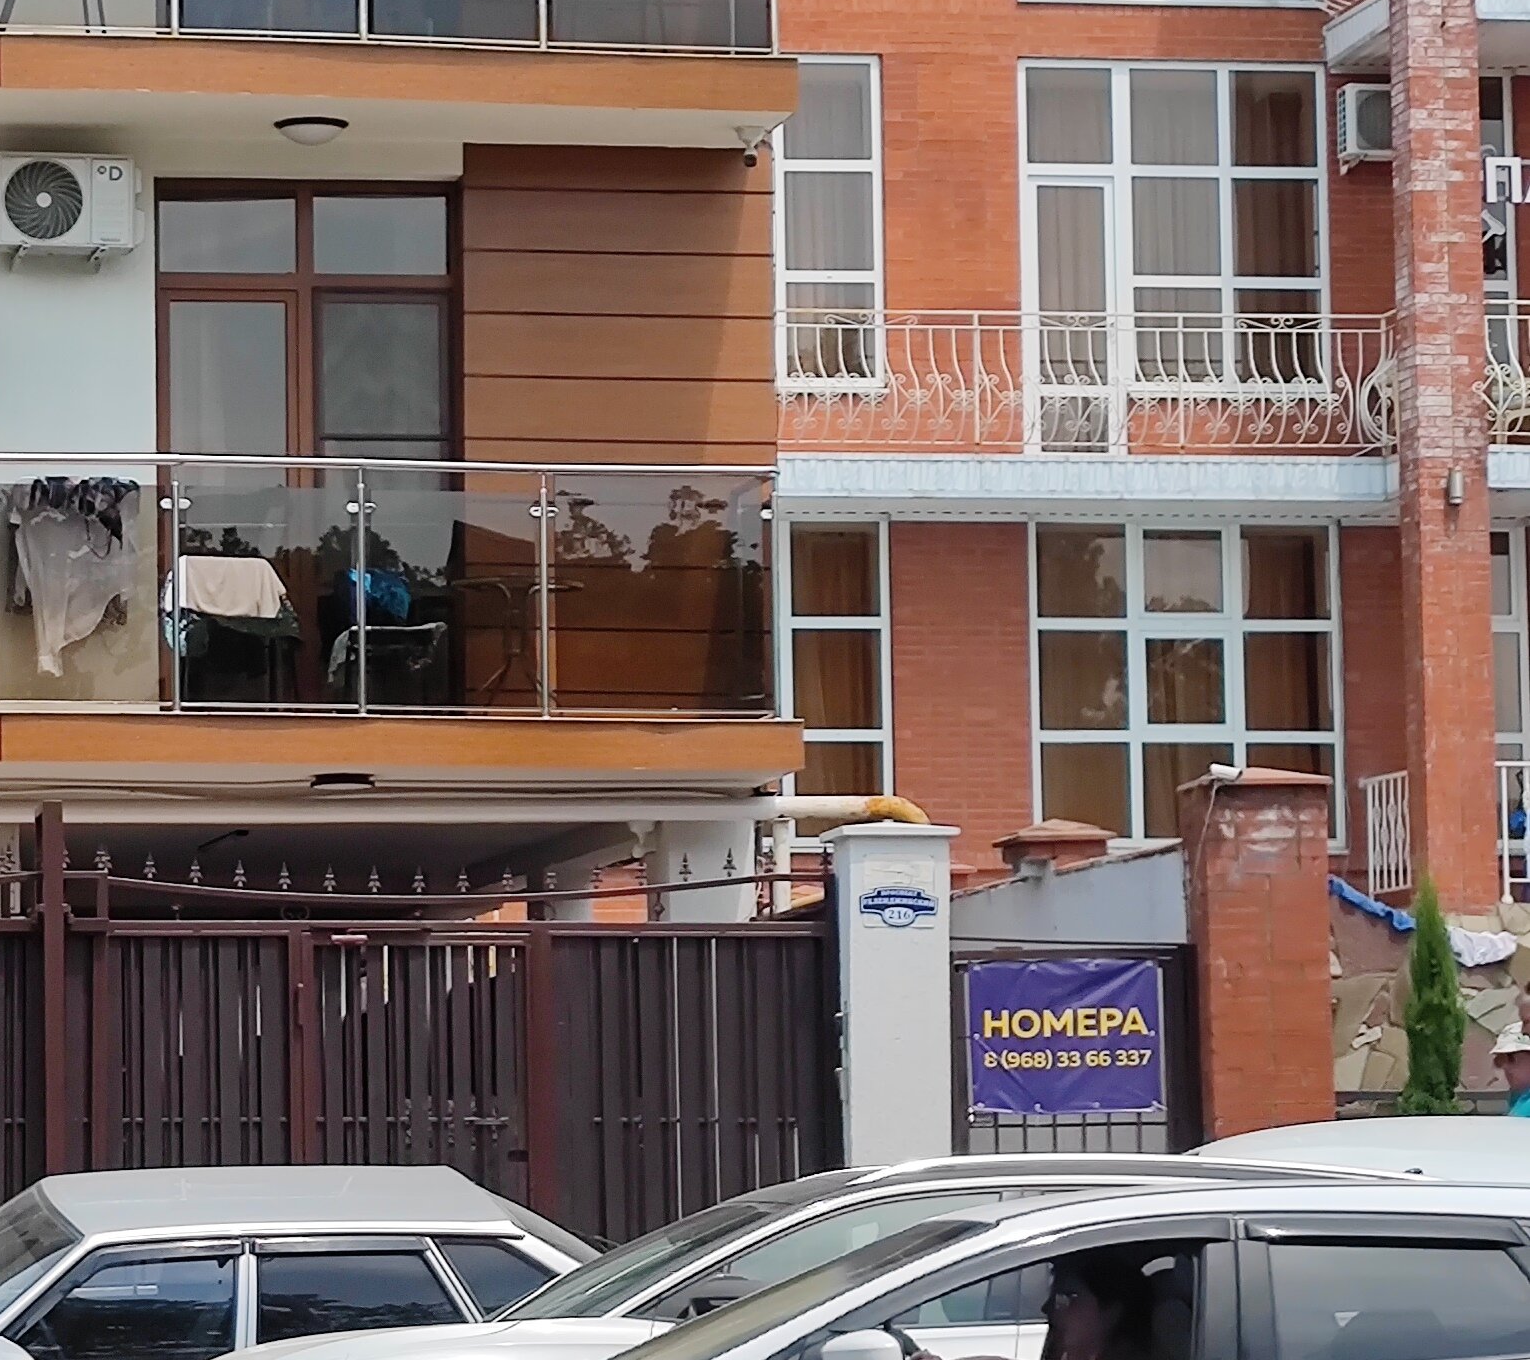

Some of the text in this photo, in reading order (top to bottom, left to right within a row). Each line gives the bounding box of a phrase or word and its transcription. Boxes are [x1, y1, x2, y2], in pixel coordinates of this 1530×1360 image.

[888, 909, 911, 920] 216
[983, 1007, 1149, 1039] НОМЕРА
[1001, 1049, 1053, 1070] (968)
[1056, 1050, 1081, 1068] 33
[1085, 1050, 1112, 1068] 66
[1115, 1049, 1152, 1067] 337
